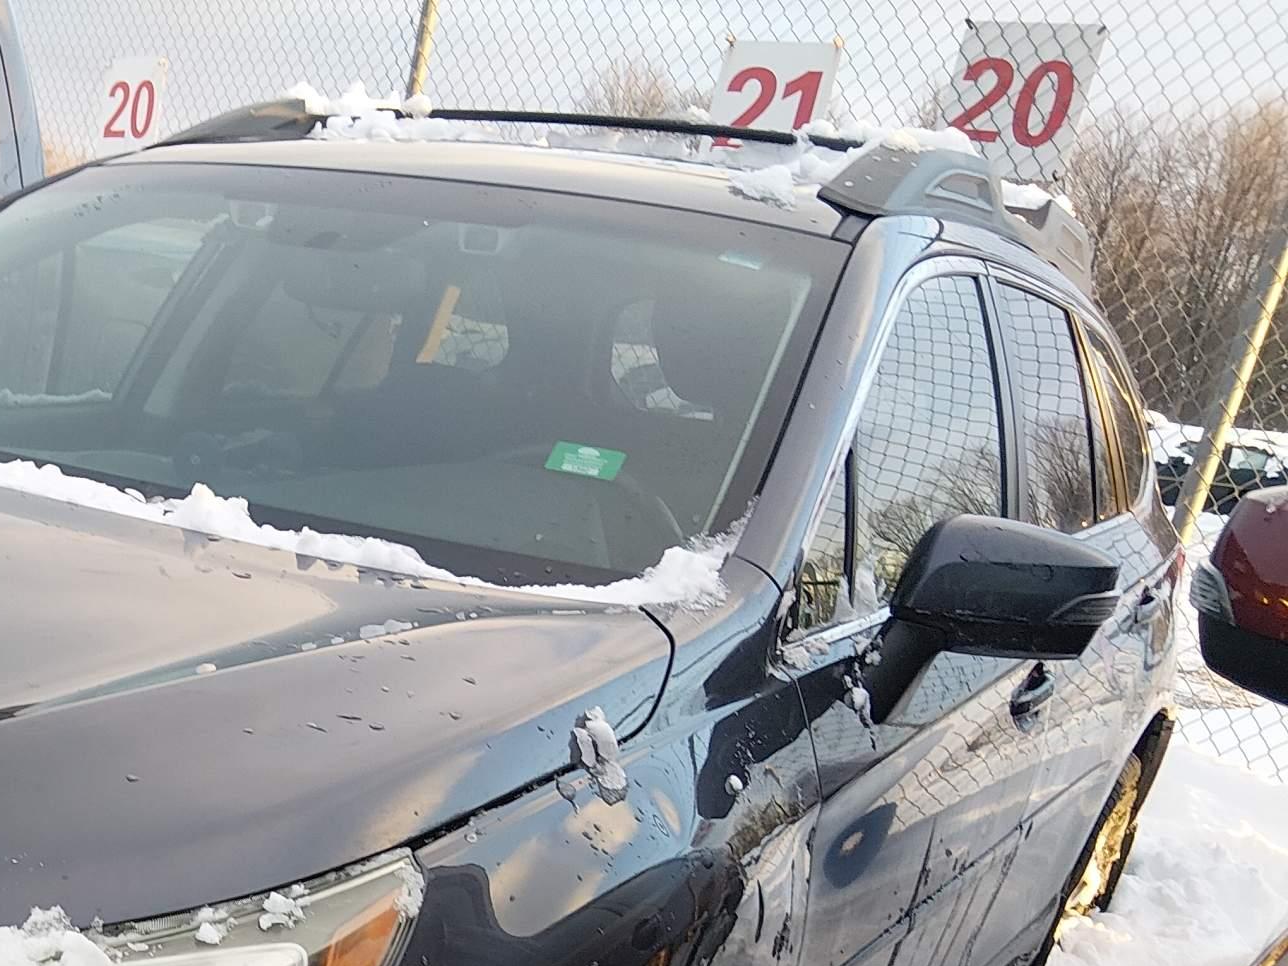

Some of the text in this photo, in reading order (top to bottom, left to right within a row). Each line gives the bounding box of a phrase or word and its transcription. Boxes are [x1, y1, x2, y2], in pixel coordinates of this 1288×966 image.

[103, 80, 156, 139] 20
[710, 66, 824, 149] 21
[952, 57, 1075, 147] 20
